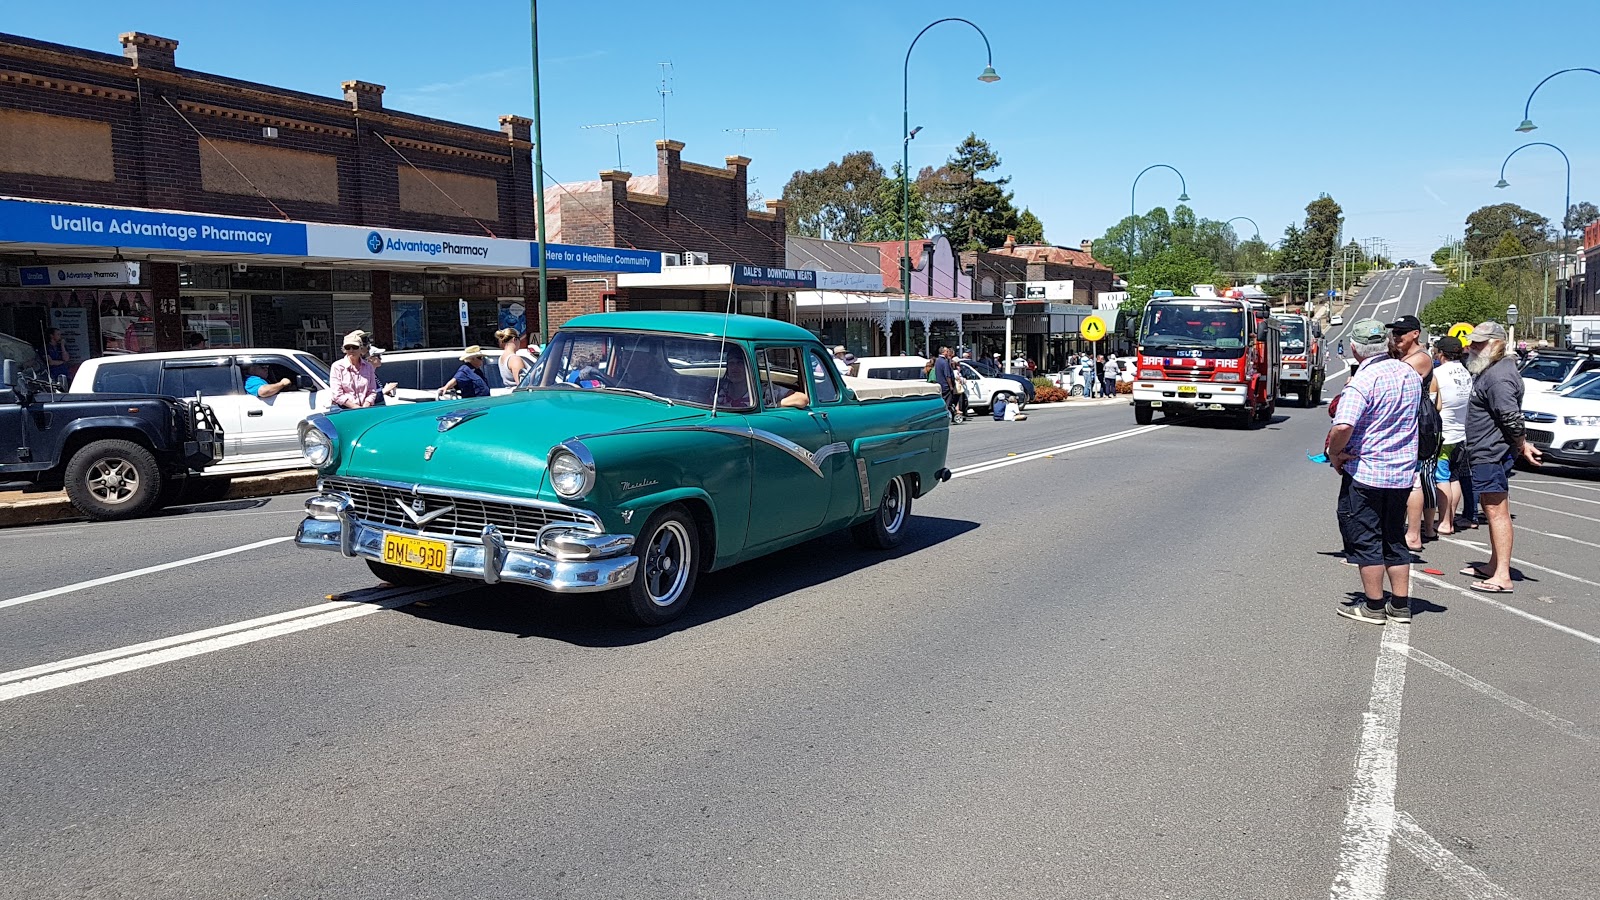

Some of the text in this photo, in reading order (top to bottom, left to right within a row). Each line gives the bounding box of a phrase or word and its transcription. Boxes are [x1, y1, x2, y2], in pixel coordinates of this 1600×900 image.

[51, 215, 272, 246] Uralla Advantage Pharmacy
[386, 238, 489, 258] Advantage Pharmacy
[546, 250, 563, 261] Here
[564, 251, 575, 262] for
[583, 253, 614, 264] Healthier
[615, 256, 651, 268] Community
[67, 271, 119, 280] Advantage Pharmacy
[743, 266, 763, 278] DALE'S
[767, 268, 796, 280] DOWNTOWN
[797, 270, 813, 281] MEATS
[1215, 359, 1238, 368] FIRE
